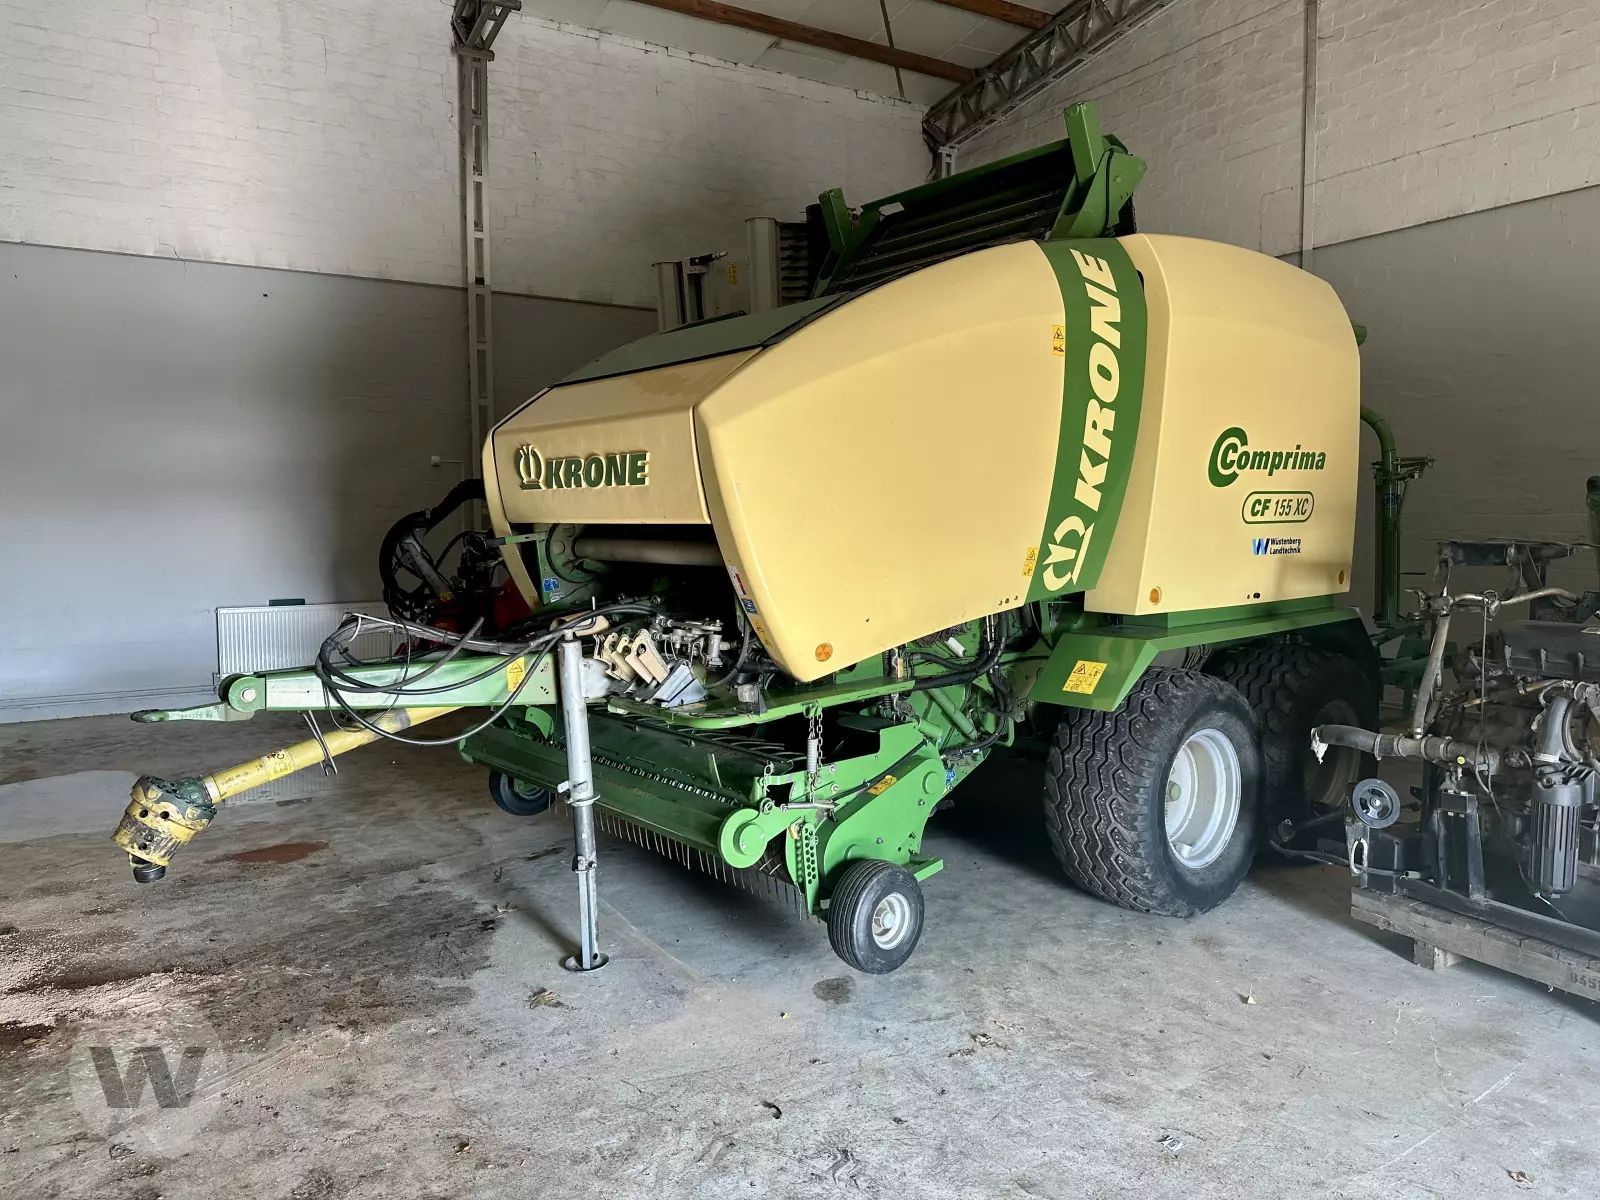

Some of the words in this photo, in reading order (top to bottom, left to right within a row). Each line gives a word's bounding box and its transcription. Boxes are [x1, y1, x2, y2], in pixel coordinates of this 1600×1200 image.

[1069, 248, 1121, 512] KRONE
[546, 450, 650, 490] KRONE
[1250, 498, 1271, 517] CF
[1273, 499, 1293, 517] 155
[1293, 498, 1309, 516] XC
